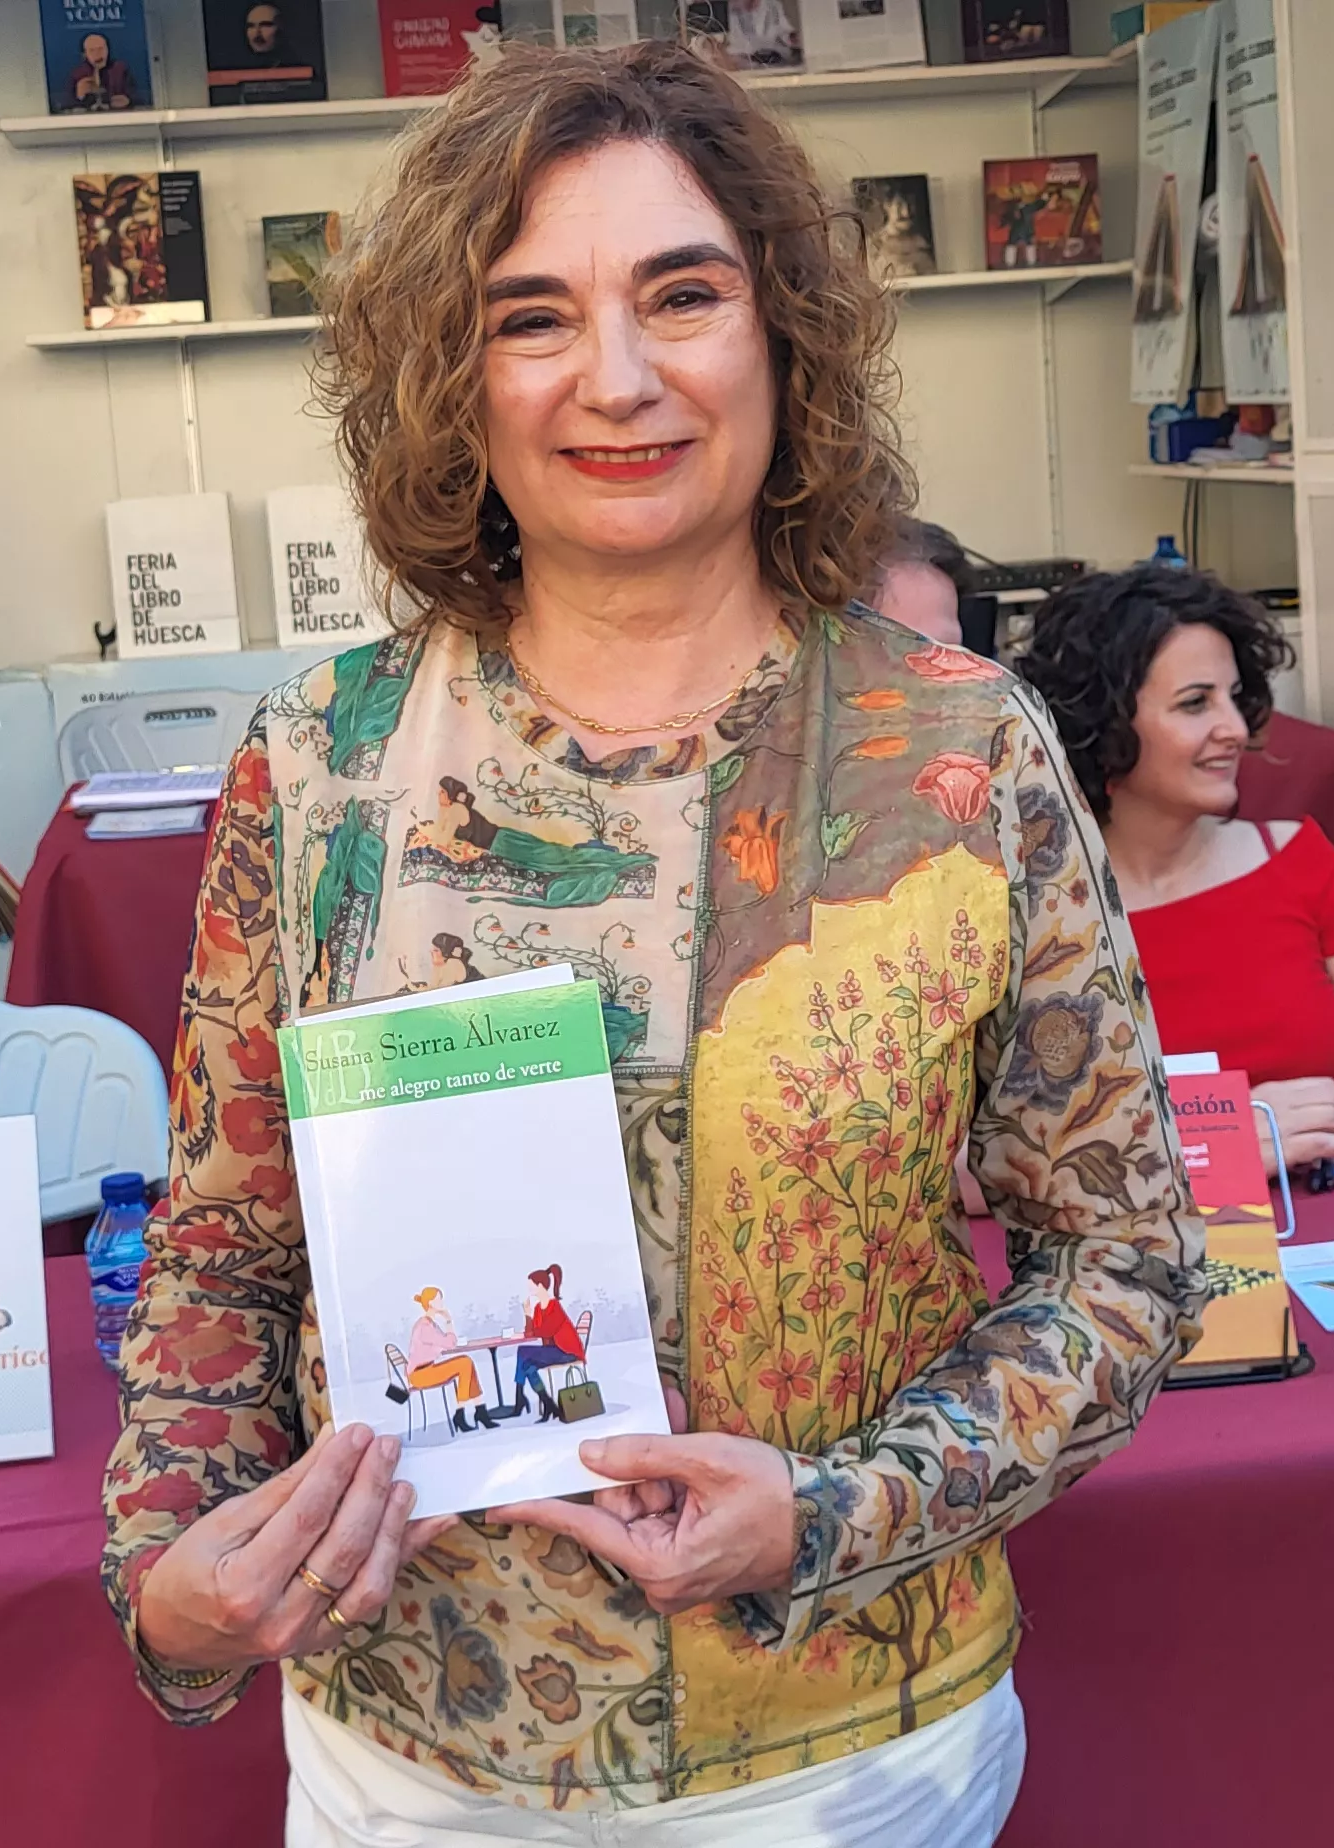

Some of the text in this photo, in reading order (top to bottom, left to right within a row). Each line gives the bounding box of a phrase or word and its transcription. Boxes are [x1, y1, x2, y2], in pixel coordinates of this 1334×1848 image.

[287, 542, 336, 560] FERIA
[127, 553, 177, 571] FERIA
[289, 561, 319, 579] DEL
[129, 573, 160, 590] DEL
[290, 578, 340, 597] LIBRO
[130, 590, 182, 609] LIBRO
[292, 598, 313, 615] DE
[133, 610, 154, 628] DE
[293, 613, 365, 634] HUESCA
[134, 625, 207, 646] HUESCA
[306, 1012, 560, 1072] Susana Sierra Álvarez
[359, 1058, 562, 1101] me alegro tanto de verte
